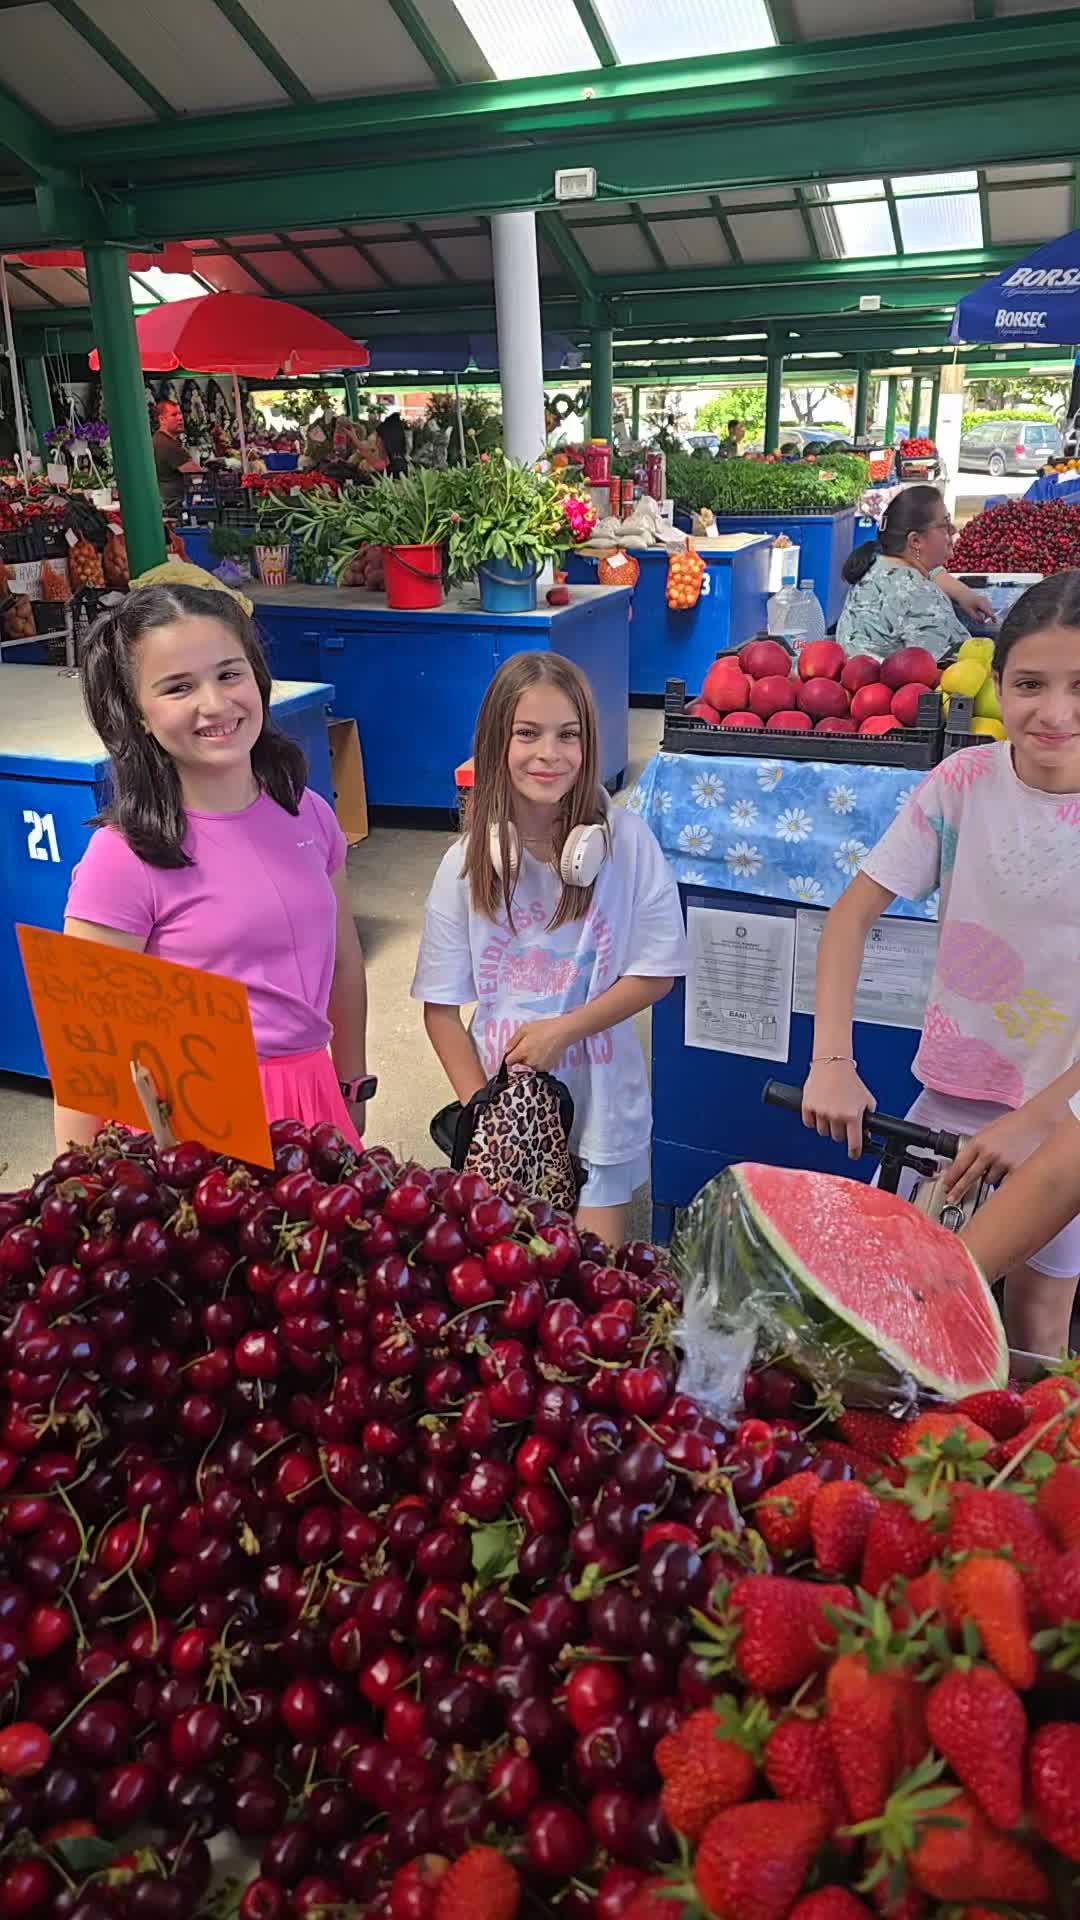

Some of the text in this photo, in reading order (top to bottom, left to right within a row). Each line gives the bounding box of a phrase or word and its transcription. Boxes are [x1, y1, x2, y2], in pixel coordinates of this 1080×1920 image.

[995, 309, 1048, 328] BORSEC
[23, 809, 61, 863] 21
[480, 901, 546, 994] ENDLSS
